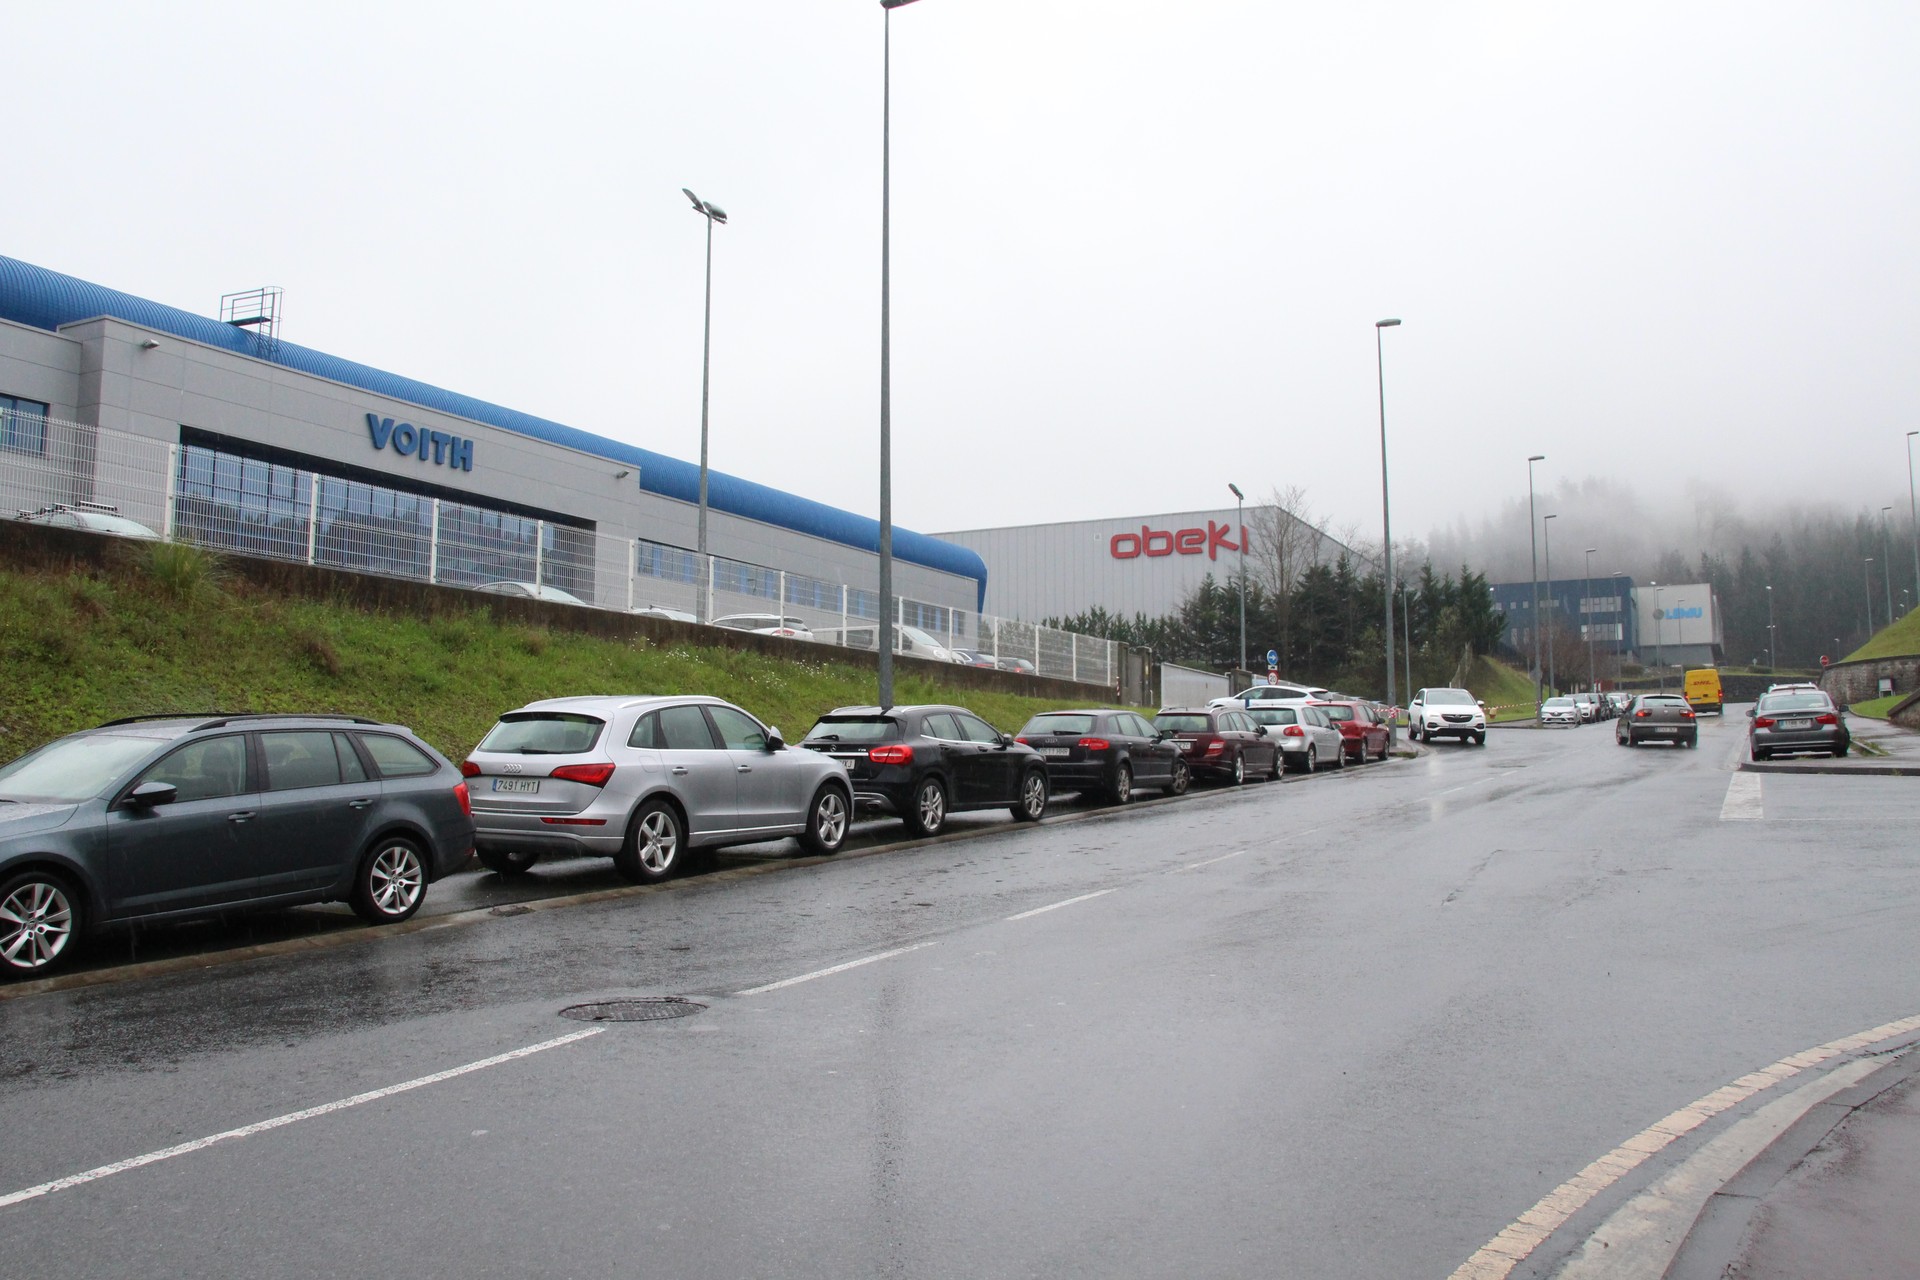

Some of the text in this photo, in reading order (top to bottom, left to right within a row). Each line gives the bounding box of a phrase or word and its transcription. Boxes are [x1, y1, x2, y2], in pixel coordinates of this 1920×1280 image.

[366, 413, 473, 472] VOITH
[497, 780, 537, 792] 7491 HYT
